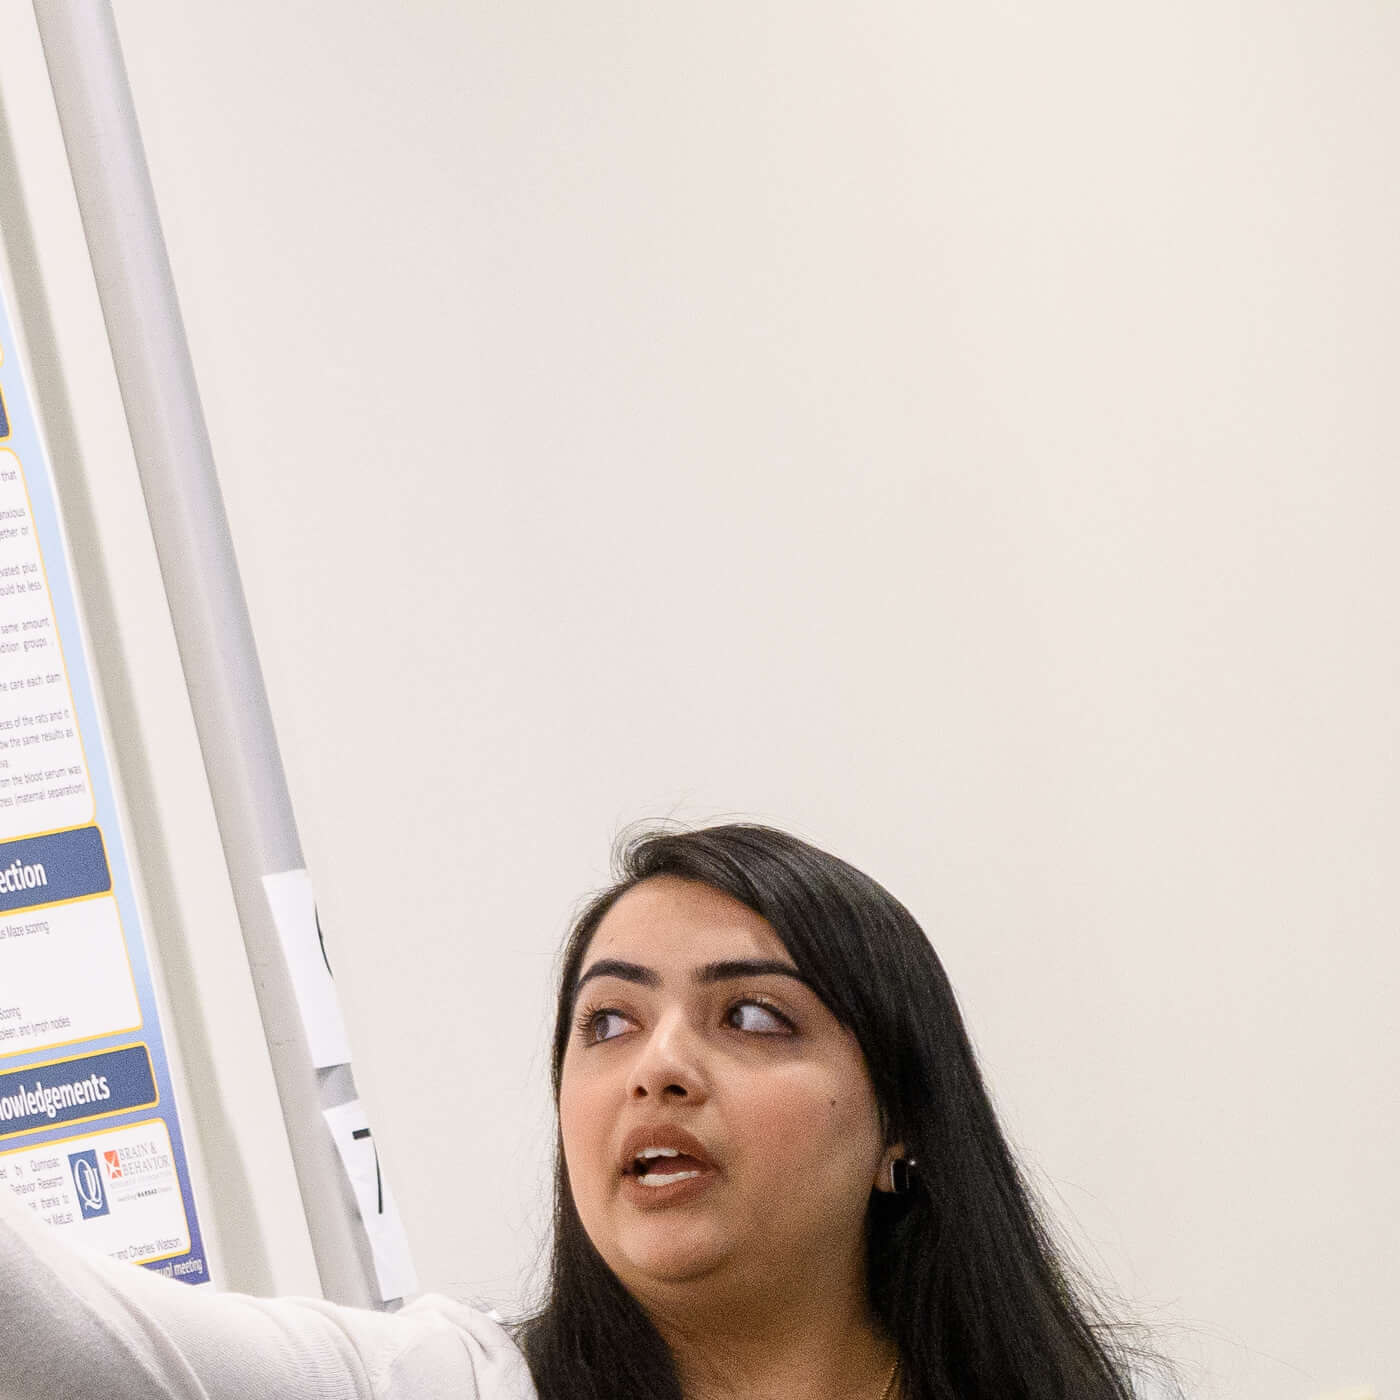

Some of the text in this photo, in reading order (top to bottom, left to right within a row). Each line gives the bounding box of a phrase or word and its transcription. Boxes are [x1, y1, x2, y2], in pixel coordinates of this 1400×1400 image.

[5, 925, 24, 937] Maze
[117, 1144, 148, 1161] BRAIN
[121, 1154, 171, 1177] BEHAVIOR
[128, 1241, 156, 1258] Charles
[157, 1237, 182, 1253] Watson
[173, 1258, 204, 1276] meeting
